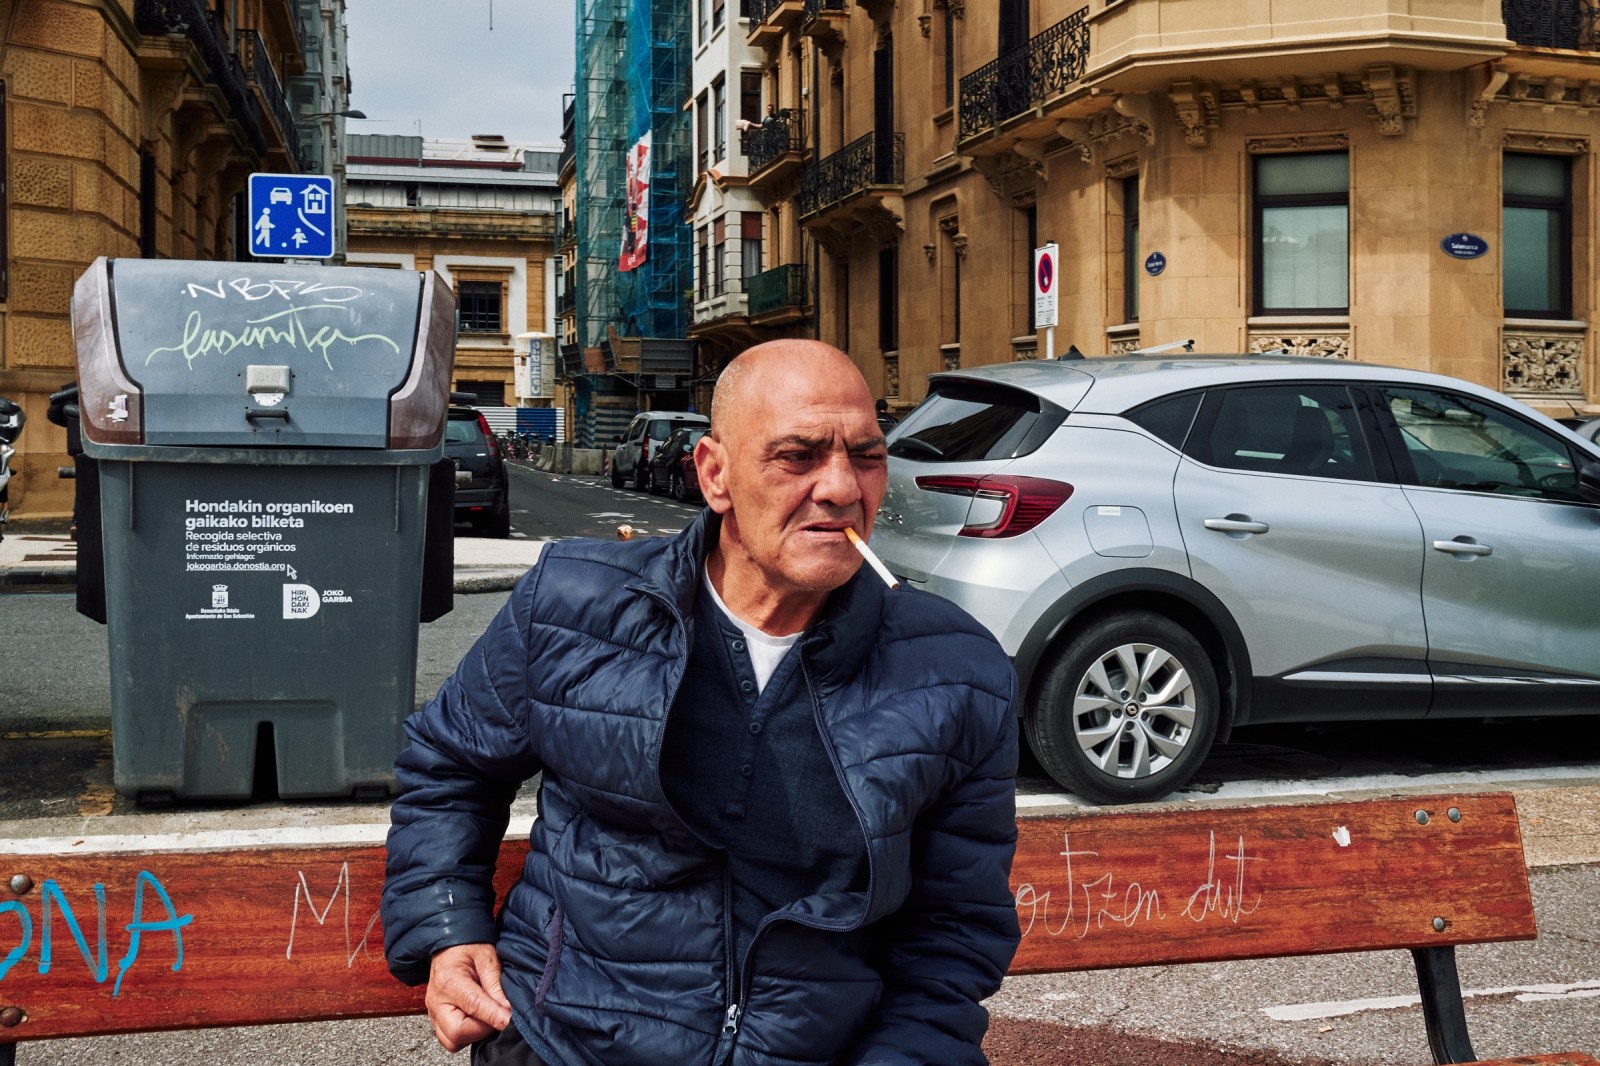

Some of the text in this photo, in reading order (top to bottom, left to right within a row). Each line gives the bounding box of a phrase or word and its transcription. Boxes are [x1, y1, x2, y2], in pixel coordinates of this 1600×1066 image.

[1451, 242, 1478, 250] Salamanca
[185, 499, 354, 515] Hondakin organikoen
[185, 515, 304, 530] gaikako bilketa
[185, 531, 282, 542] Recogida selectiva
[185, 542, 296, 553] de residuos orgánicos
[225, 553, 255, 562] gehiago:
[186, 562, 285, 571] jokogarbia.donostia.org
